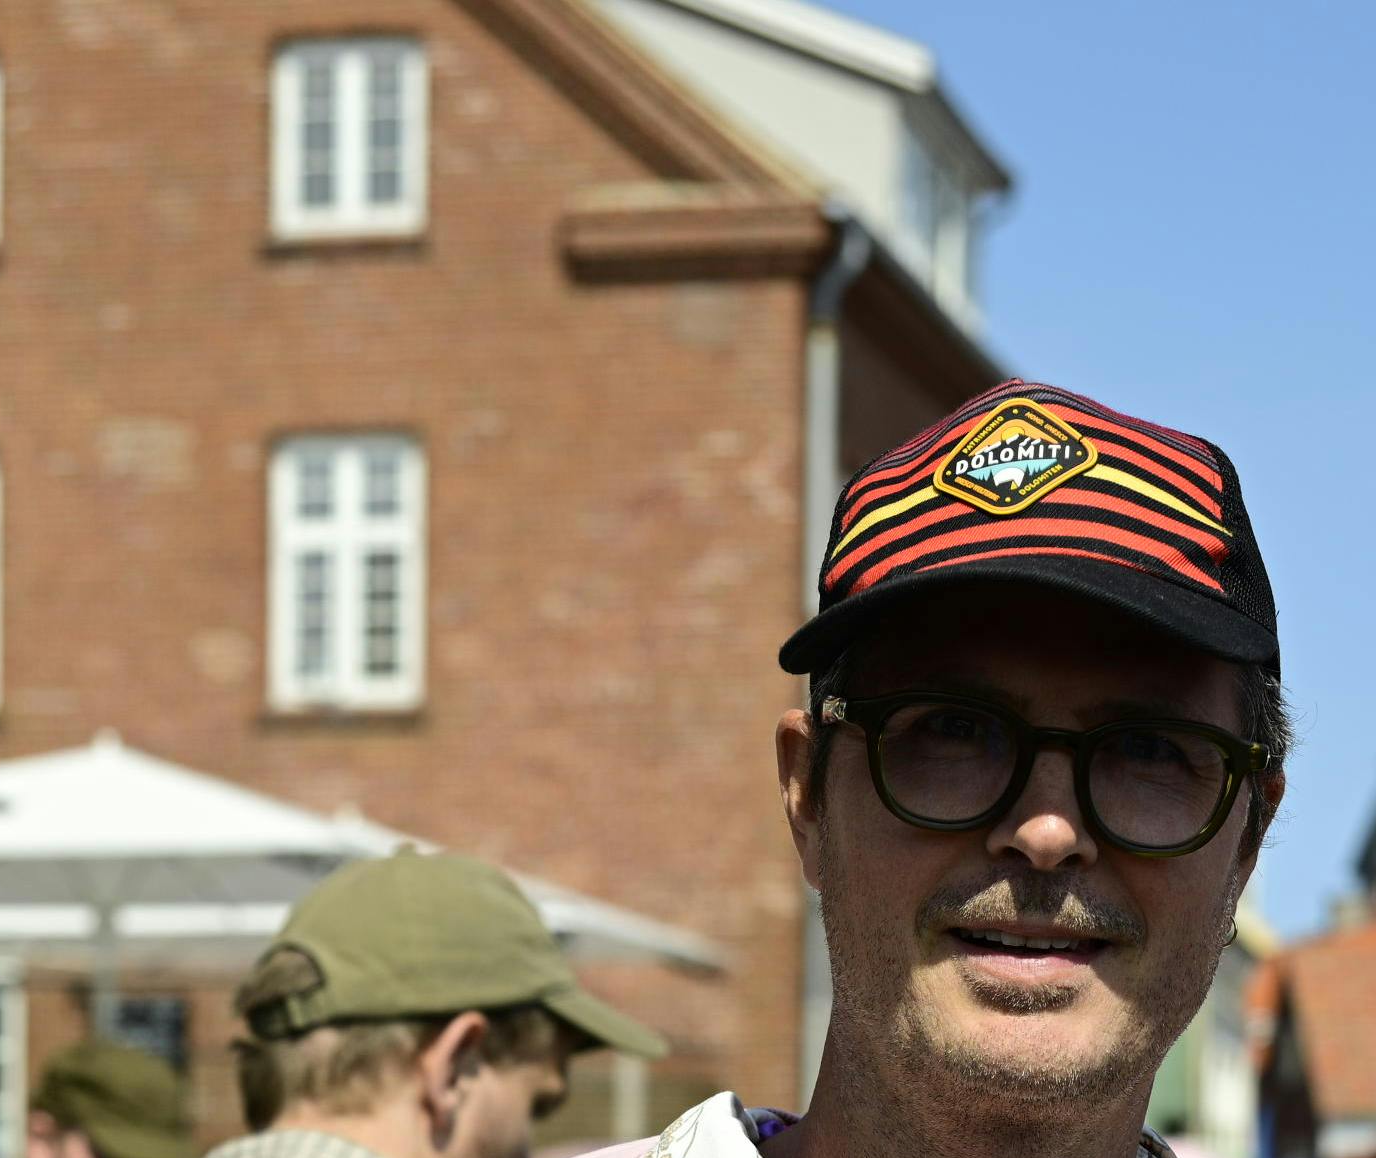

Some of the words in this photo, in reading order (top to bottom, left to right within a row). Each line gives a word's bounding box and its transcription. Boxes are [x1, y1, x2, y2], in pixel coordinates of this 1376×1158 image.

[962, 415, 1004, 454] PATRIMONIO
[955, 444, 1070, 475] DOLOMITI
[1018, 464, 1064, 495] DOLOMITEN
